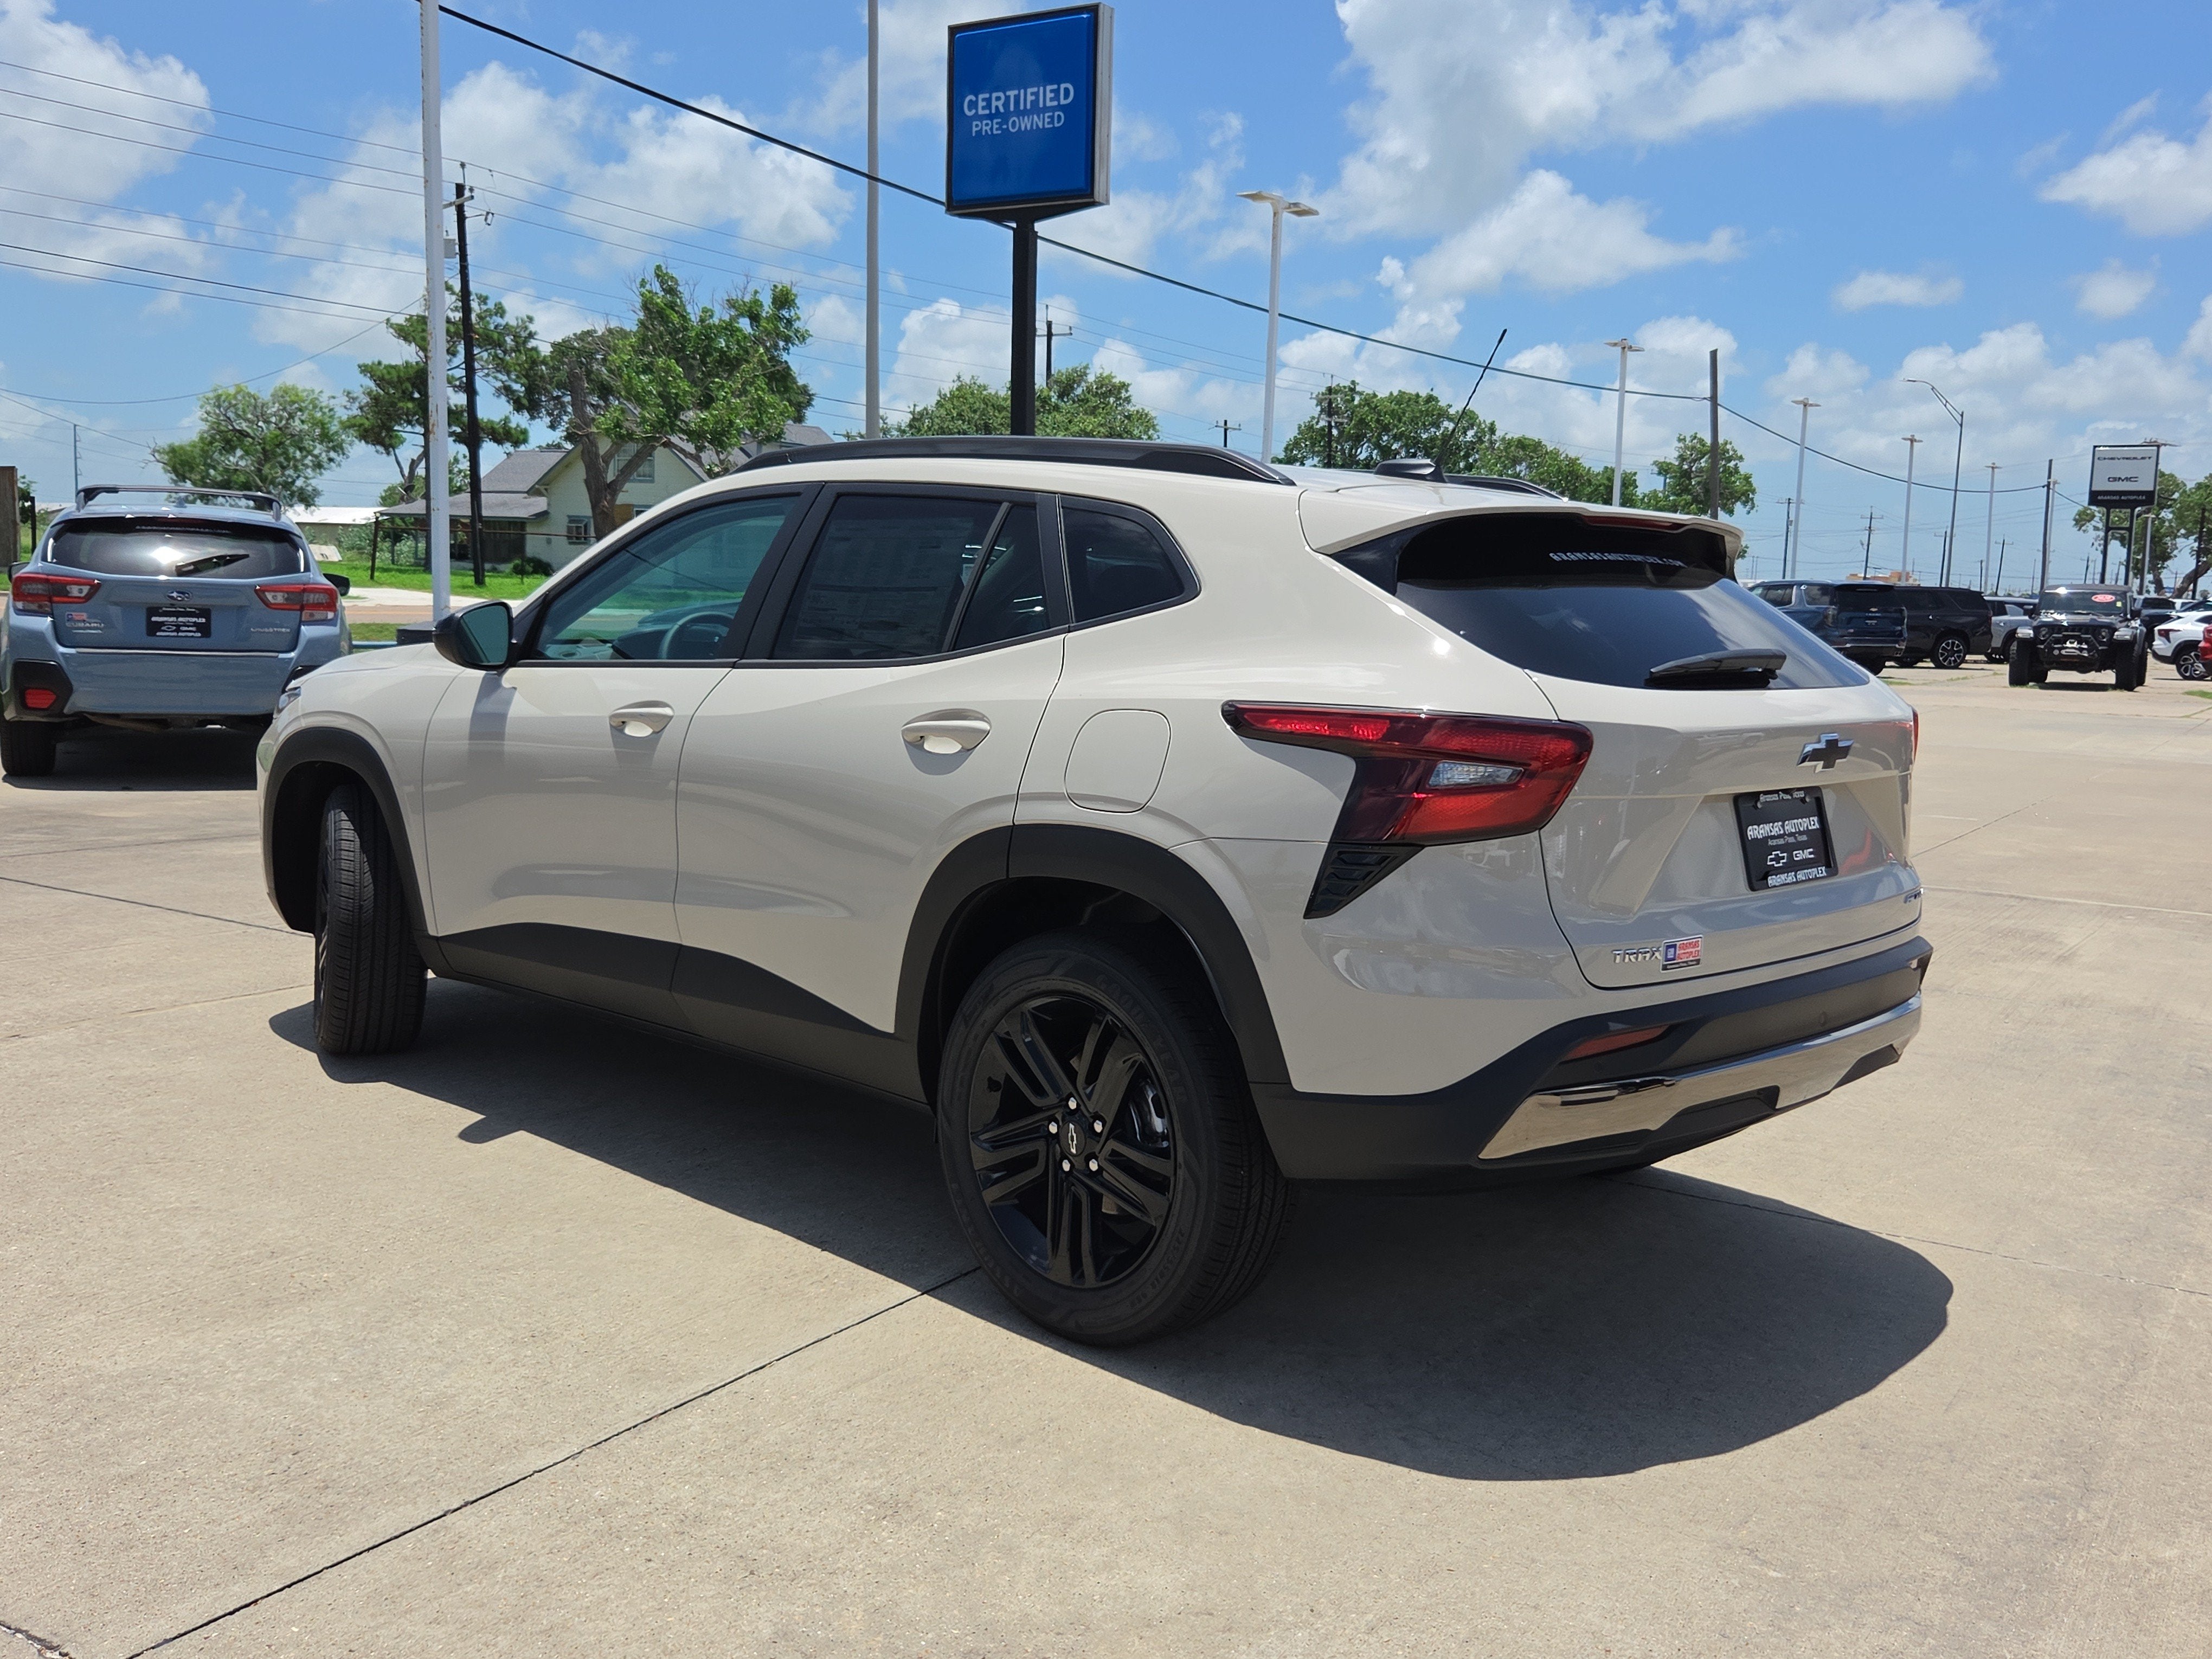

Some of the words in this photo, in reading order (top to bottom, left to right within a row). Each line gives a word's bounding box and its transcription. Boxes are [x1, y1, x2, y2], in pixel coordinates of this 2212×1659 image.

[963, 82, 1074, 116] CERTIFIED
[972, 111, 1064, 137] PRE-OWNED
[1747, 821, 1784, 840] ARANSAS
[1784, 816, 1819, 834] AUTOPLEX
[1793, 848, 1815, 861] GMC
[1768, 871, 1797, 888] ARANSAS
[1797, 866, 1827, 882] AUTOPLEX
[1611, 947, 1662, 964] TRAX
